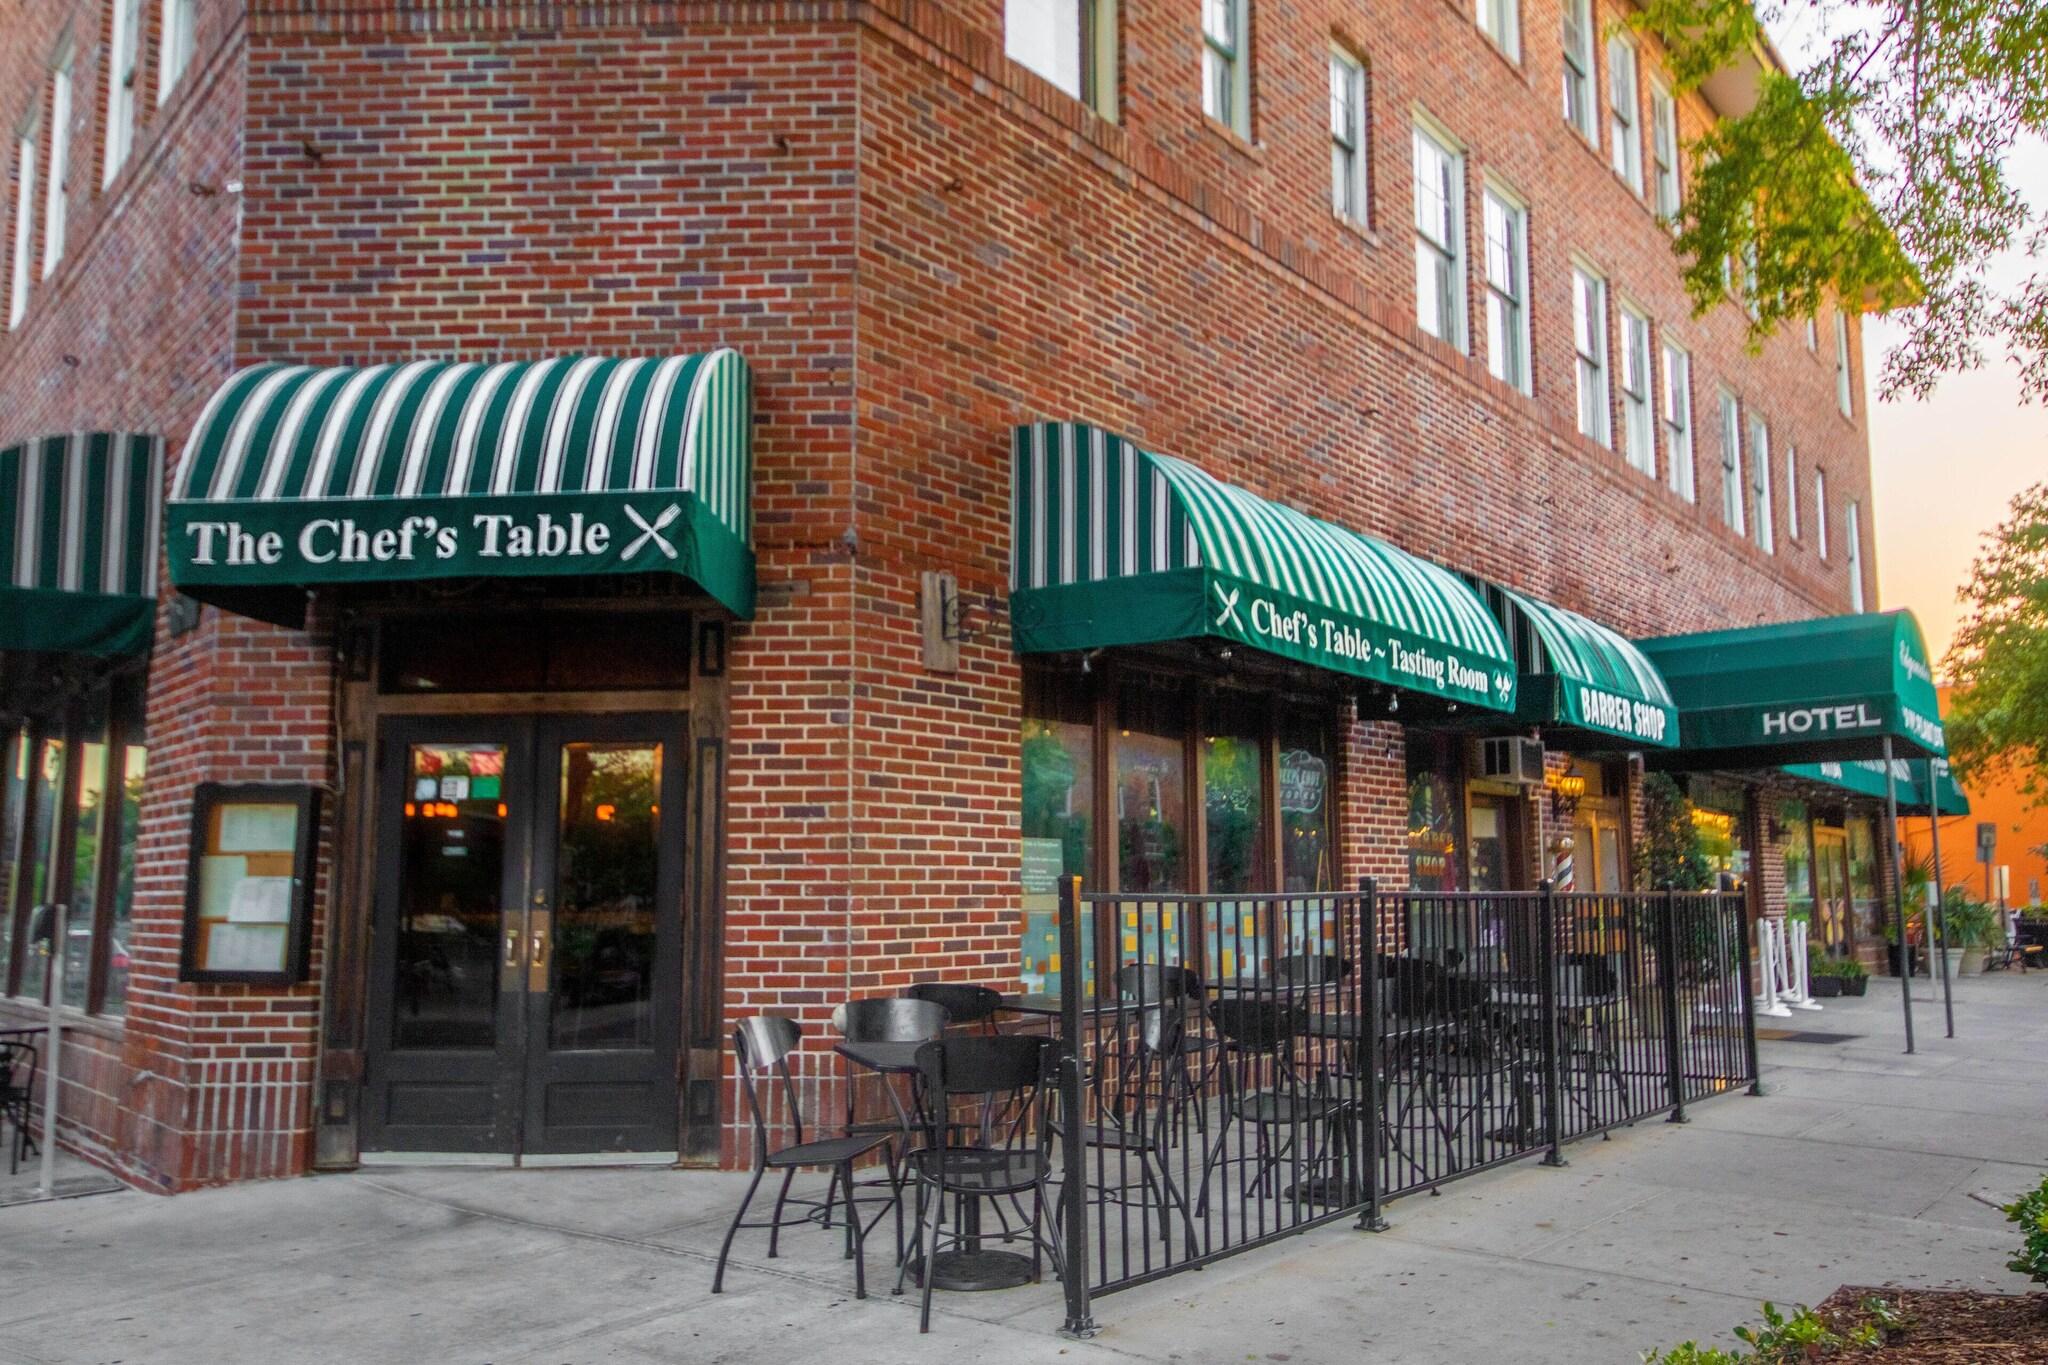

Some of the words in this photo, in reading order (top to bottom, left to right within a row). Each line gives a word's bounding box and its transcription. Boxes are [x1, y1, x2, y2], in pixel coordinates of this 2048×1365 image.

[186, 521, 283, 565] The
[299, 516, 458, 564] Chef's
[473, 512, 610, 557] Table
[1251, 599, 1318, 648] Chef's
[1321, 618, 1371, 662] Table
[1388, 638, 1445, 689] Tasting
[1447, 655, 1488, 693] Room
[1581, 687, 1632, 733] BARBER
[1634, 701, 1665, 741] SHOP
[1763, 704, 1881, 735] HOTEL
